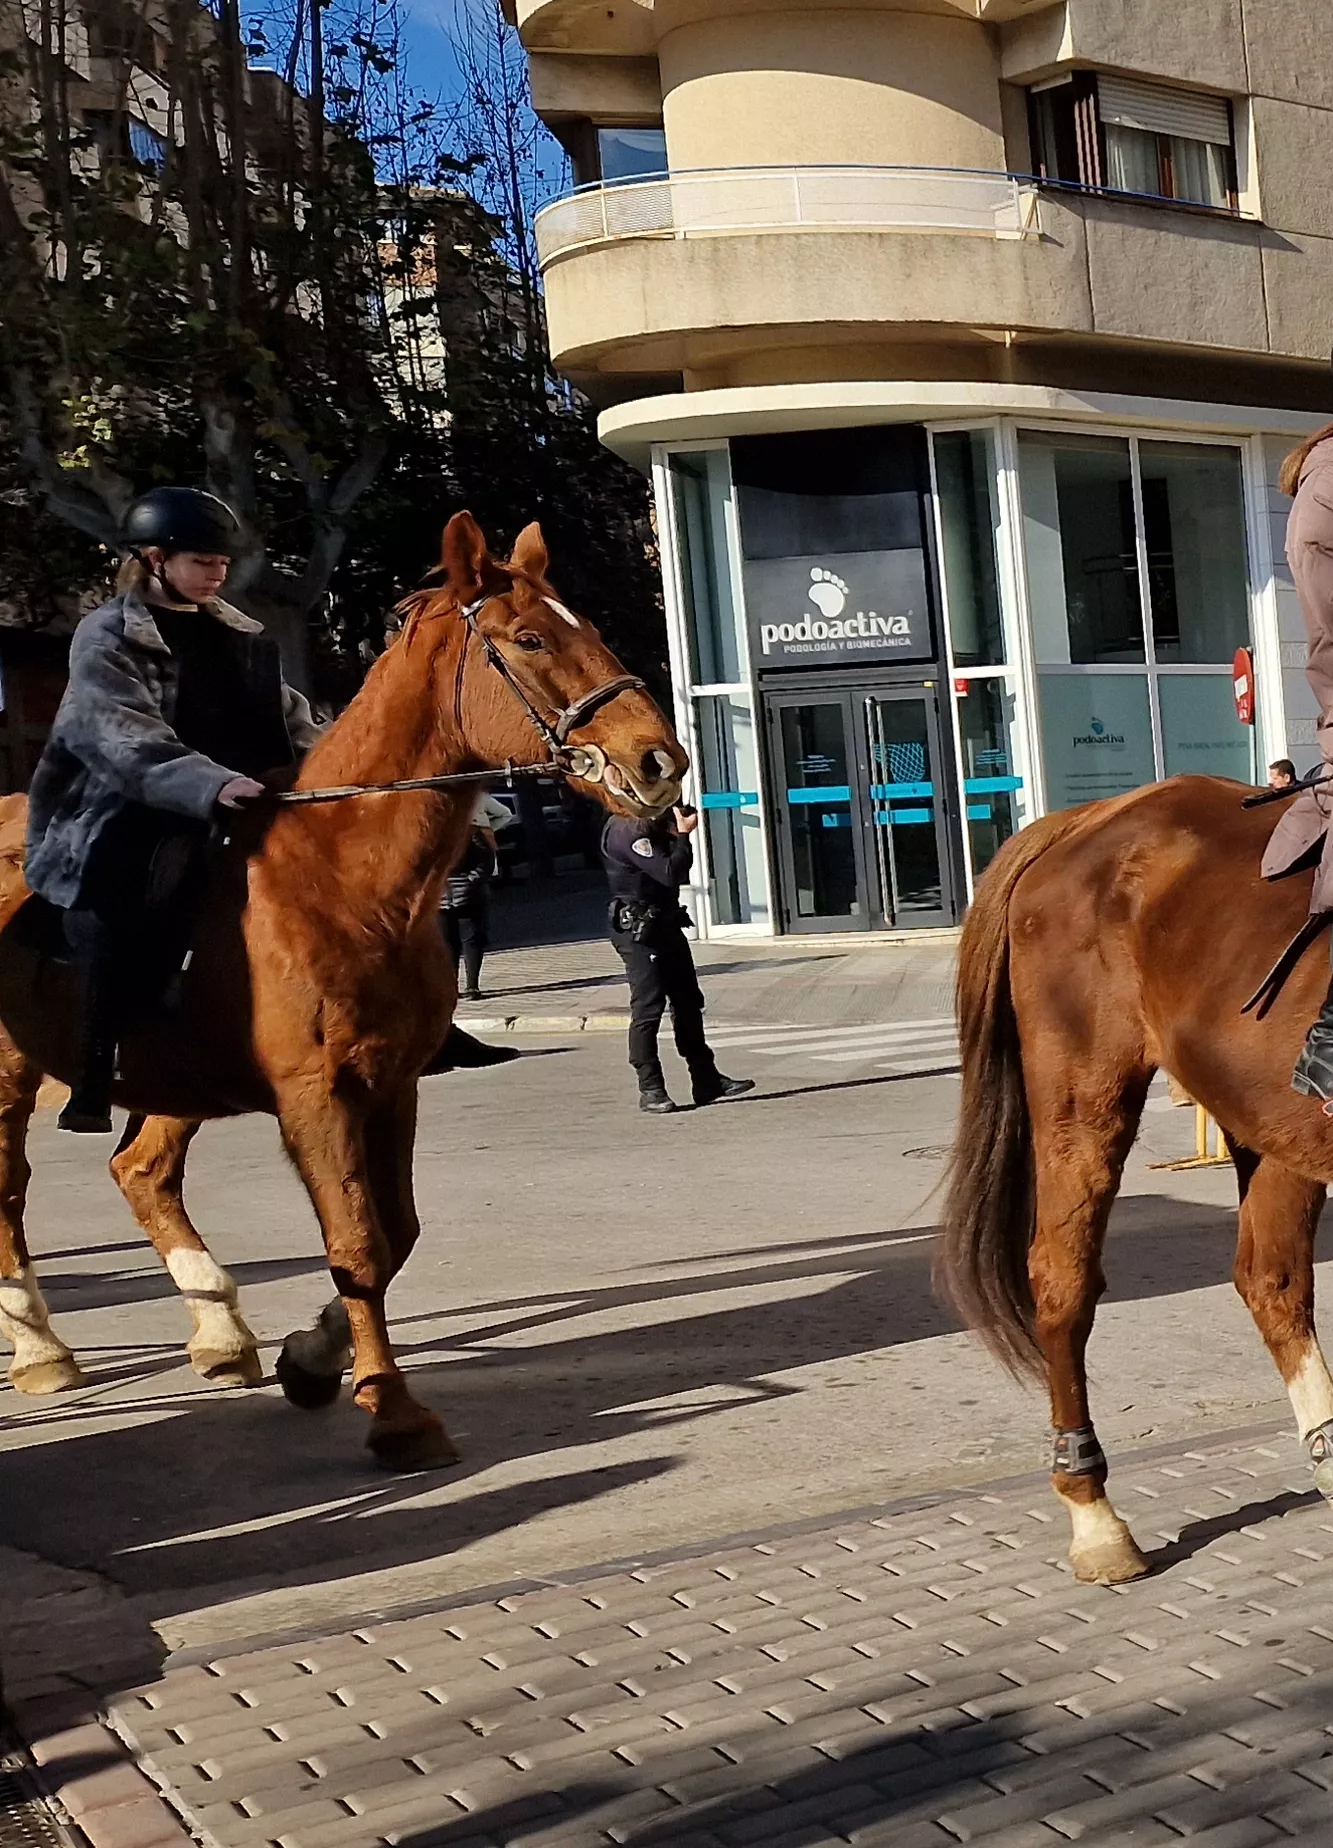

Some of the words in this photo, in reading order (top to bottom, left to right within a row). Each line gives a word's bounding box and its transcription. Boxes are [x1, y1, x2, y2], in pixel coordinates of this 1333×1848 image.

[761, 612, 911, 655] podoactiva
[784, 641, 836, 653] PODOLOGÍA
[839, 641, 845, 650] Y
[847, 637, 911, 649] BIOMECÁNICA
[1073, 734, 1125, 748] podoactiva
